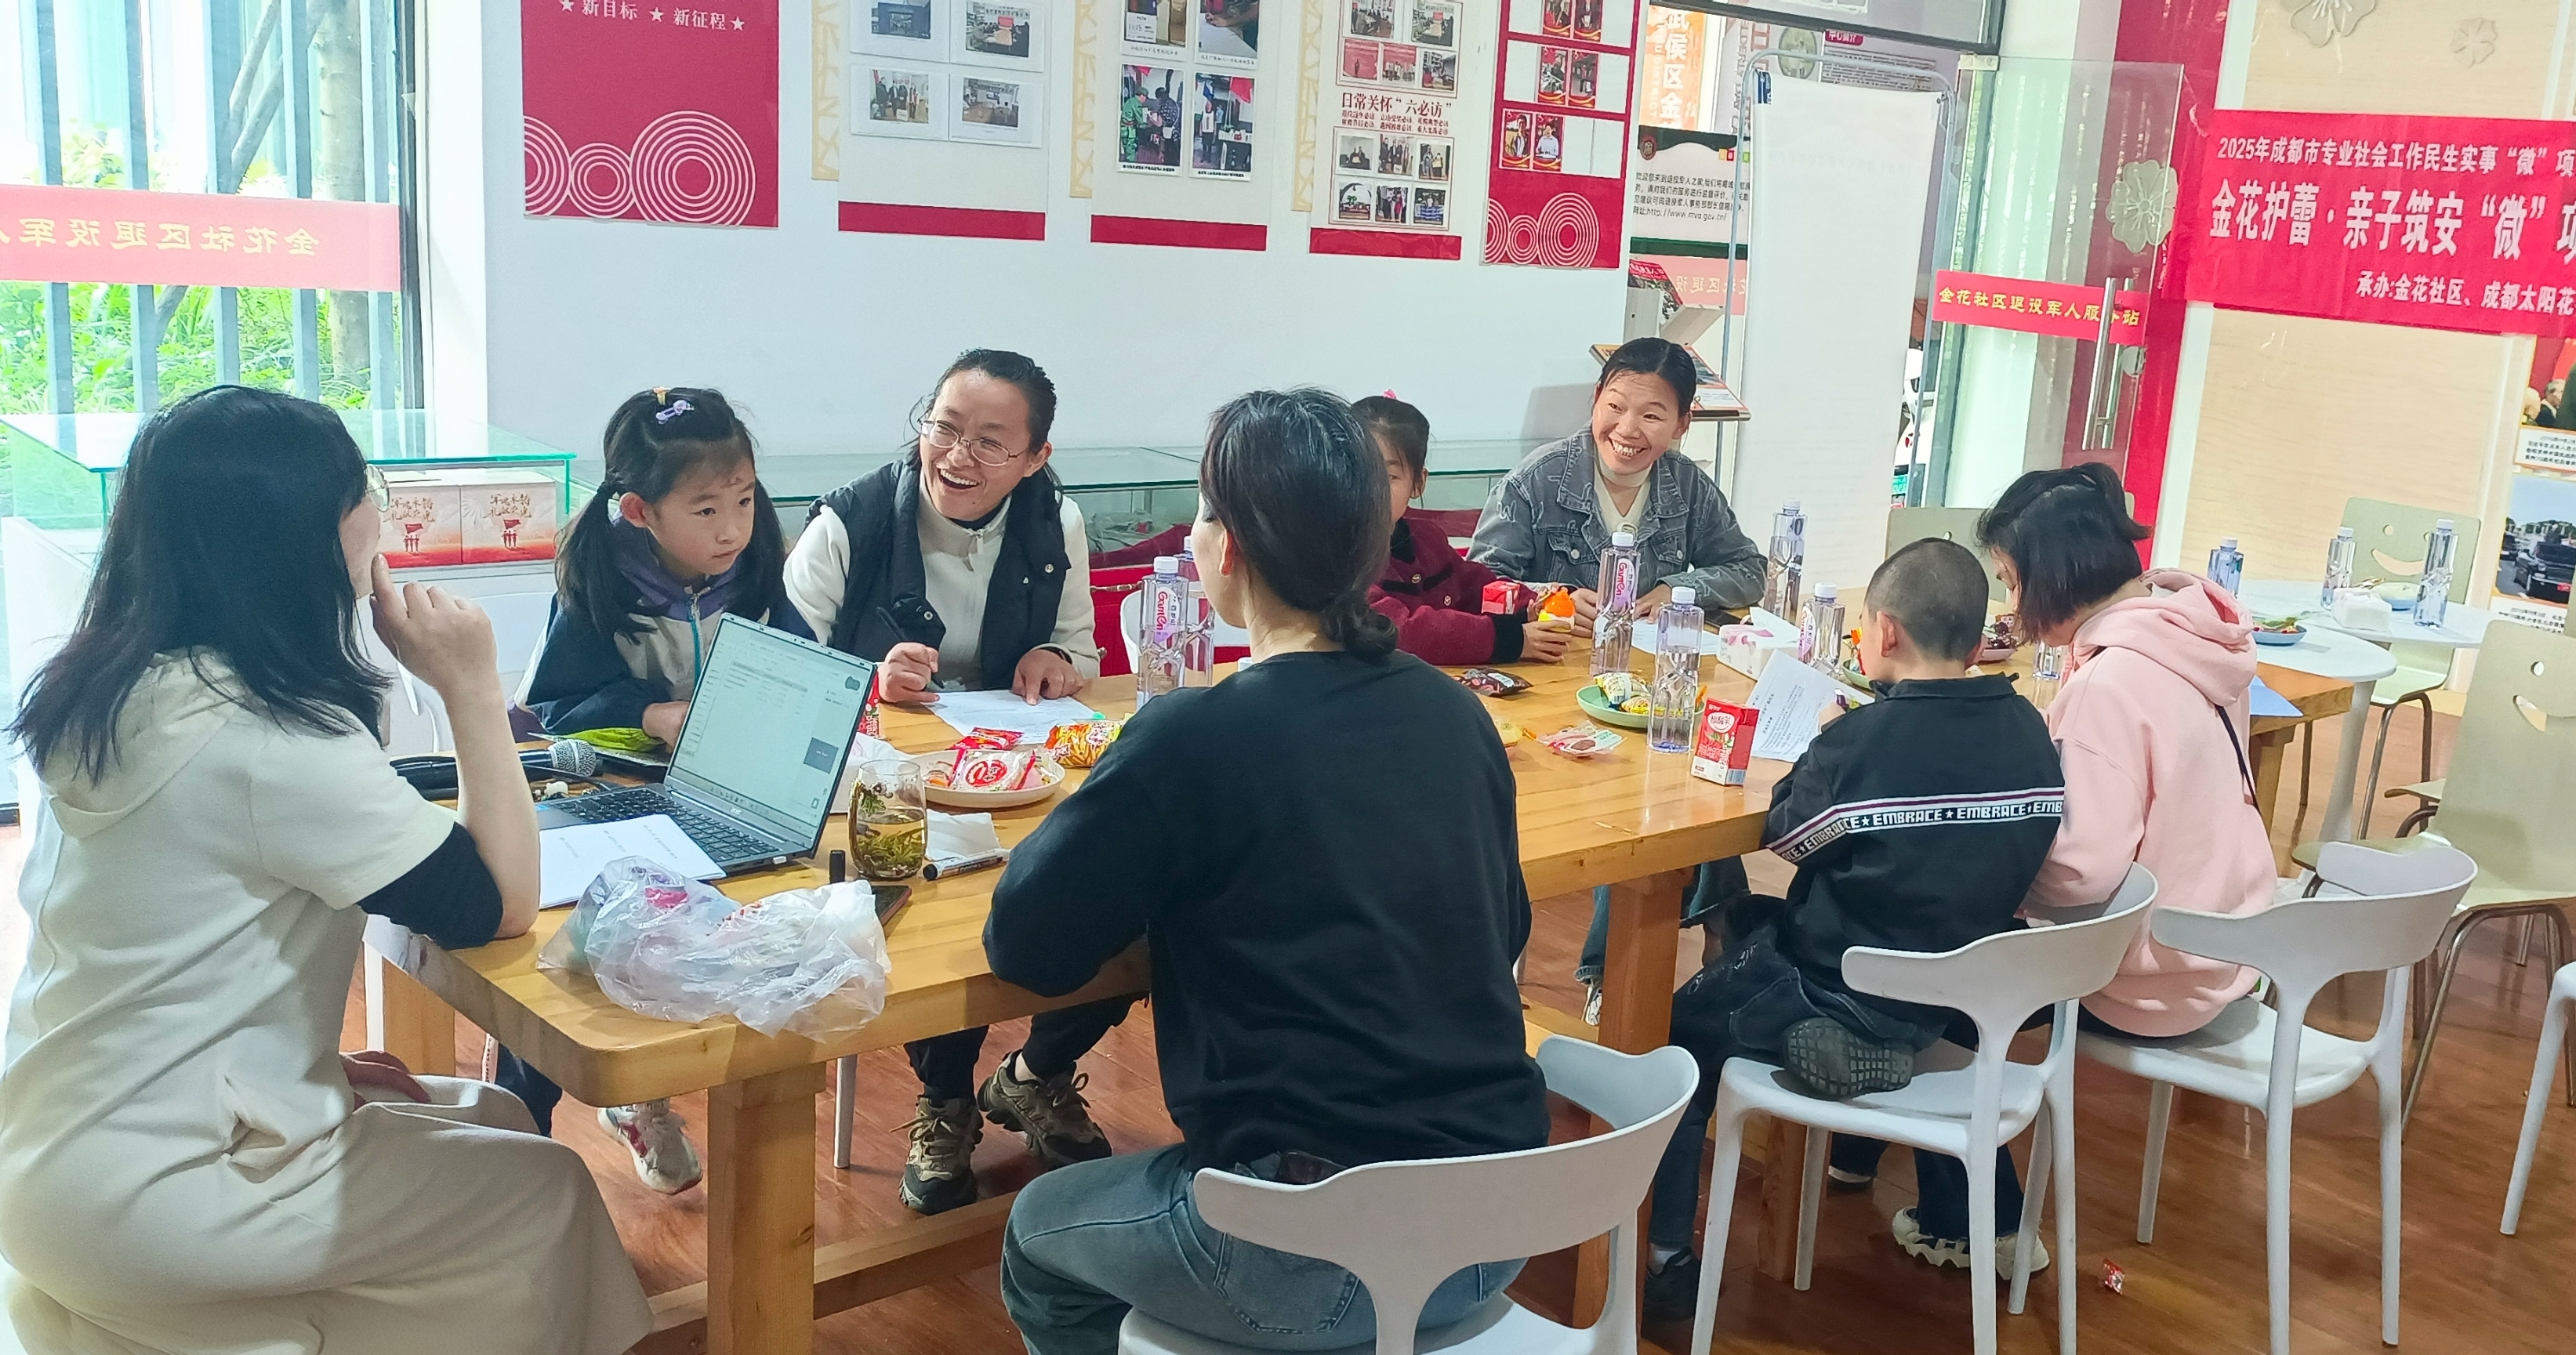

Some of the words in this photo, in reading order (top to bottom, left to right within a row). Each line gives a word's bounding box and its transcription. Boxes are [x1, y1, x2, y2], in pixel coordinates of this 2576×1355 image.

[582, 0, 638, 20] 新目标
[673, 6, 727, 31] 新征程
[1659, 13, 1691, 129] 武侯区金
[1873, 809, 1943, 826] EMBRACE
[1956, 802, 2027, 820] EMBRACE
[2032, 801, 2063, 813] EMB
